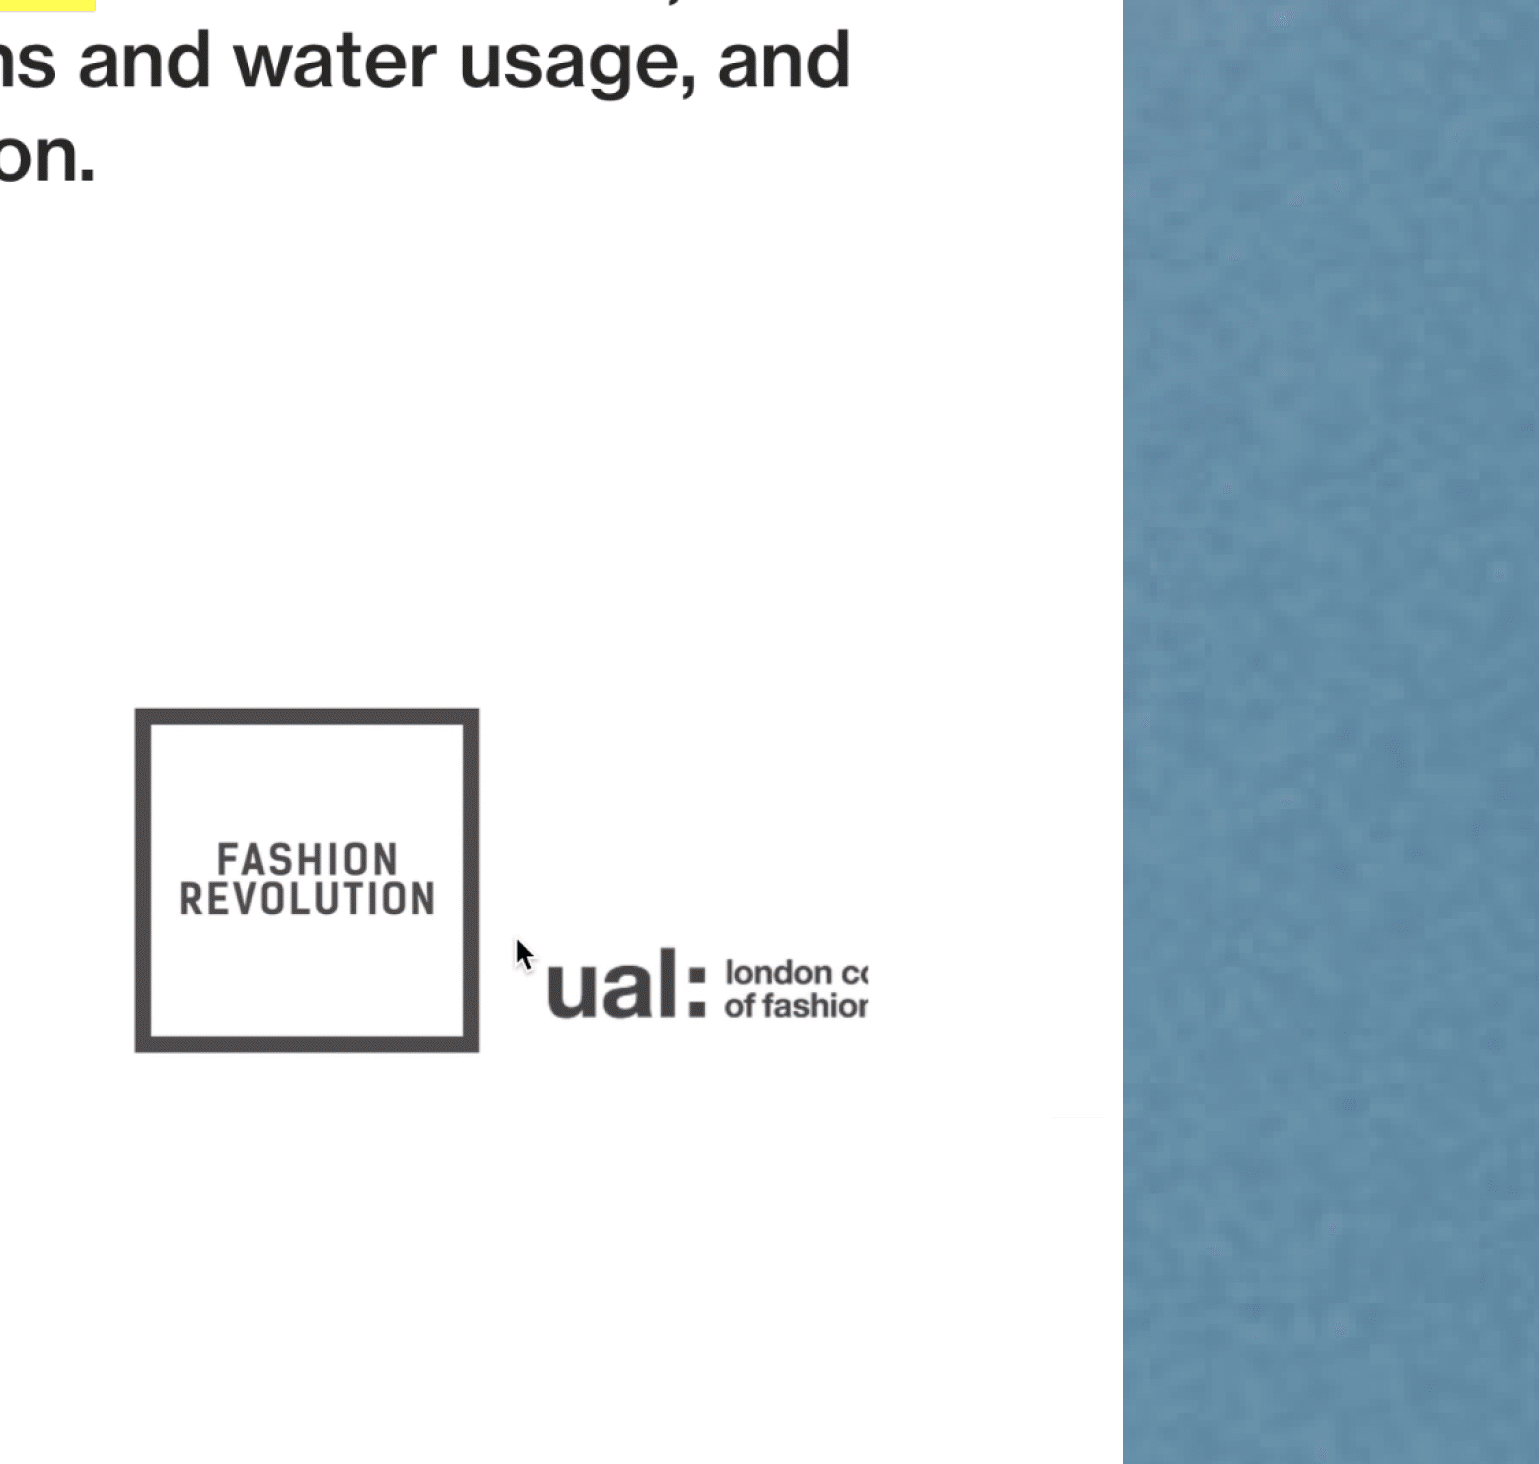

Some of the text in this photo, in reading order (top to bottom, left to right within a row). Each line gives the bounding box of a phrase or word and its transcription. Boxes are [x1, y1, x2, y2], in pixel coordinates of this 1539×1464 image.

[79, 28, 209, 89] and
[232, 32, 438, 89] water
[462, 44, 695, 102] usage,
[719, 28, 849, 89] and
[218, 841, 397, 877] FASHION
[180, 880, 434, 915] REVOLUTION
[548, 947, 706, 1019] ual:
[726, 958, 833, 986] london
[724, 991, 757, 1019] of
